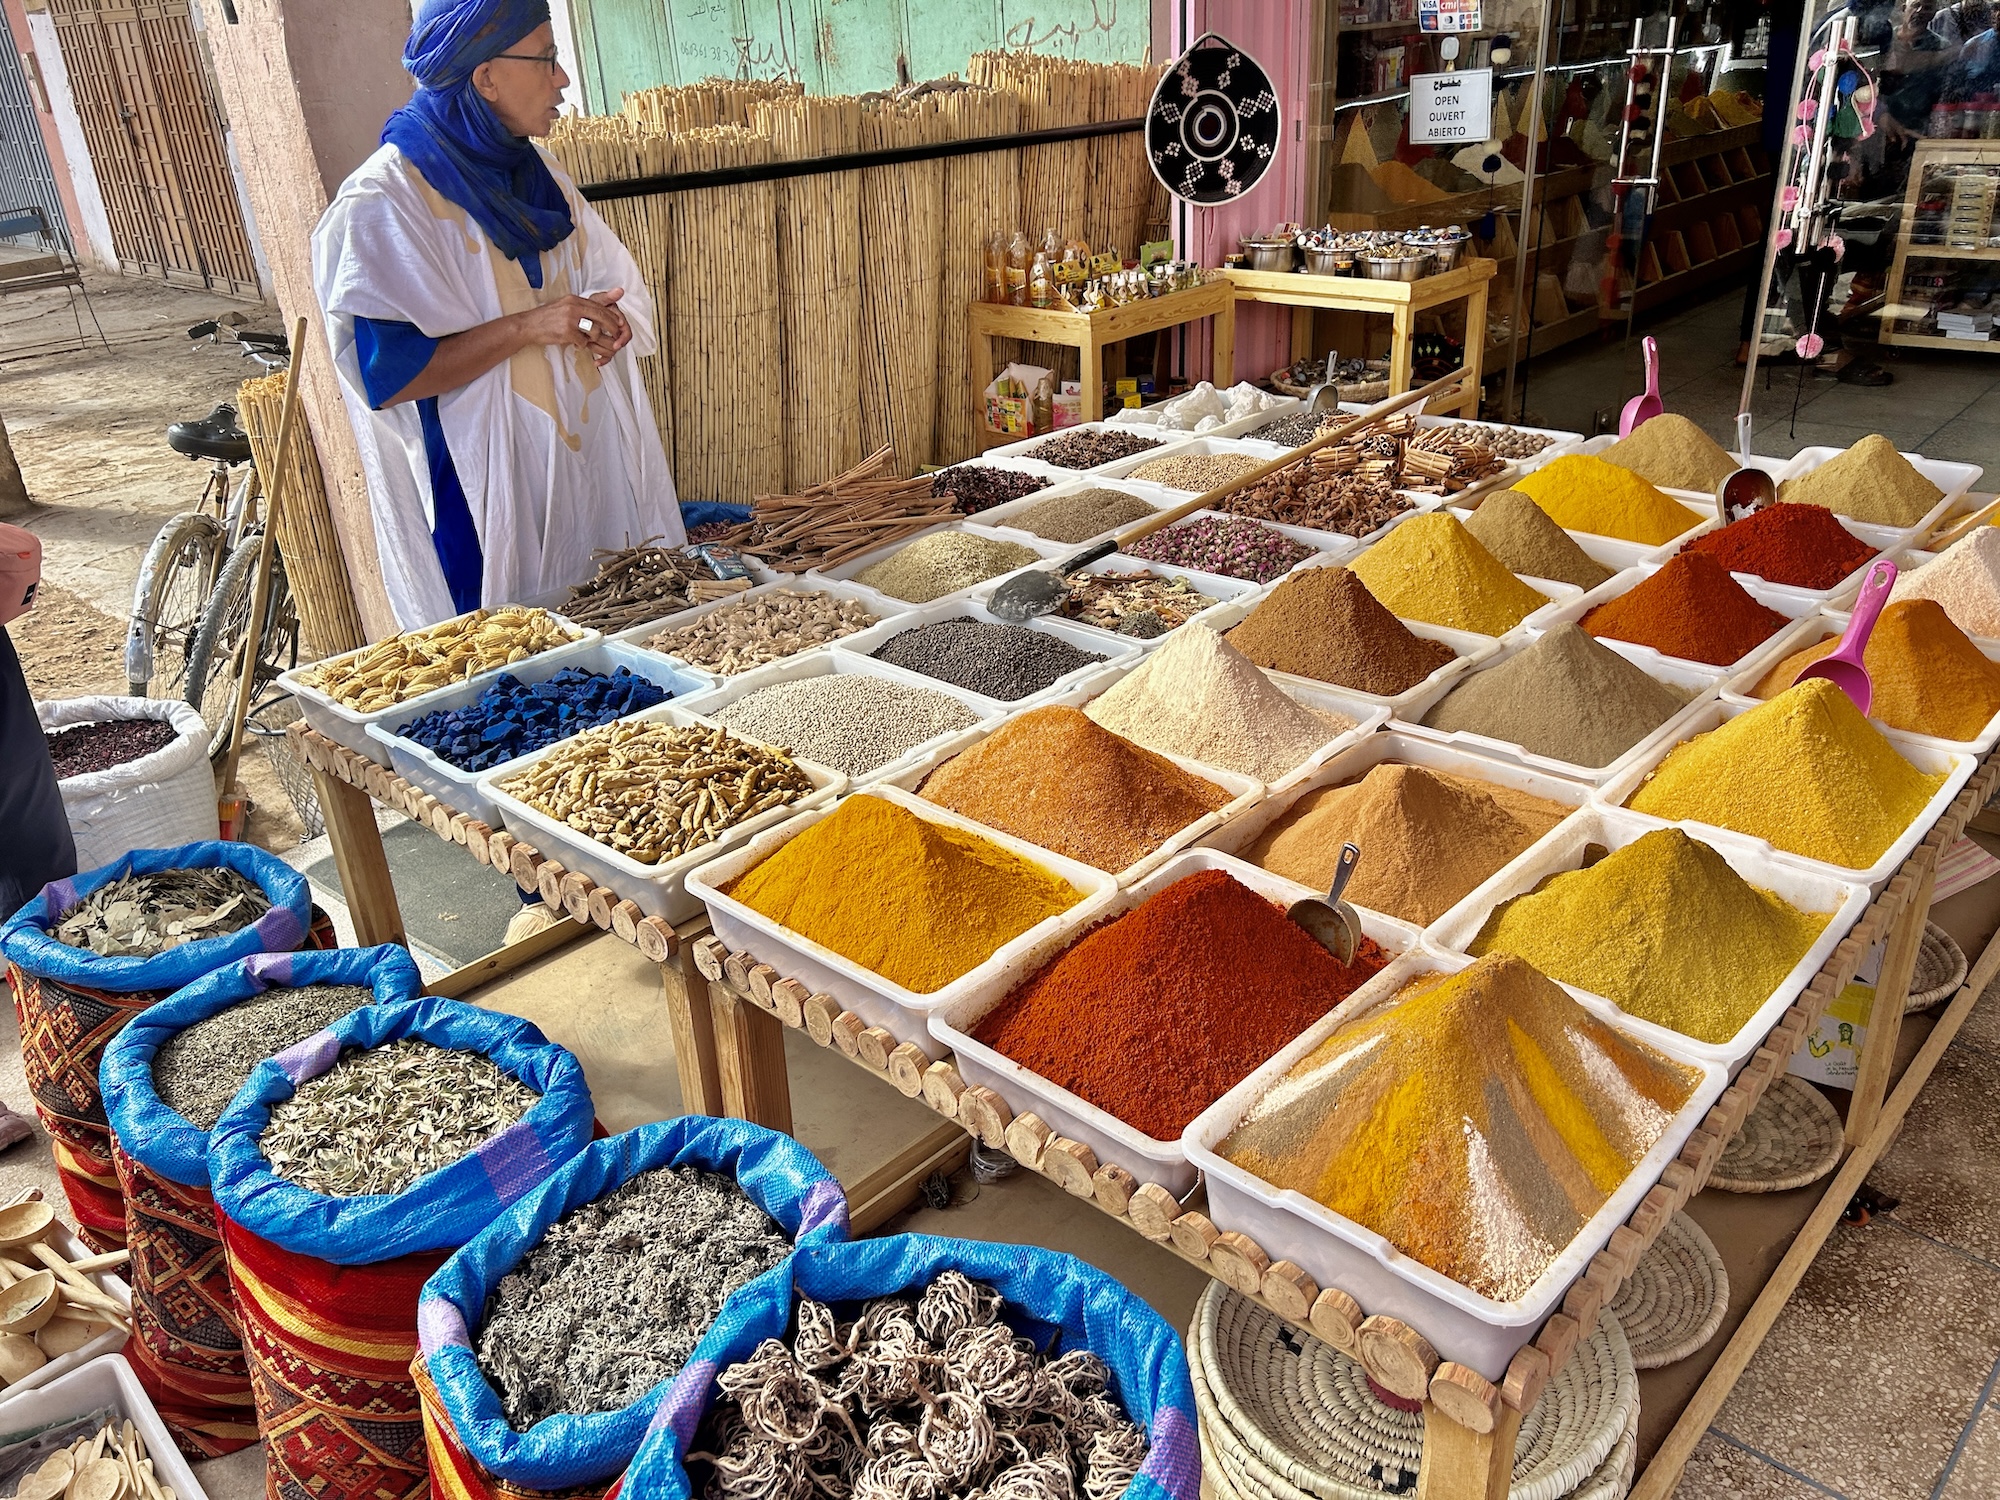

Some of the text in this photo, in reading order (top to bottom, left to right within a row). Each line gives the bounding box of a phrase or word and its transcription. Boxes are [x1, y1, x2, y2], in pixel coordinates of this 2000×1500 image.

[1421, 0, 1437, 9] VISA
[1433, 77, 1461, 91] مفتوح
[1434, 95, 1459, 106] OPEN
[1429, 110, 1466, 122] OUVERT
[1428, 126, 1466, 138] ABIERTO
